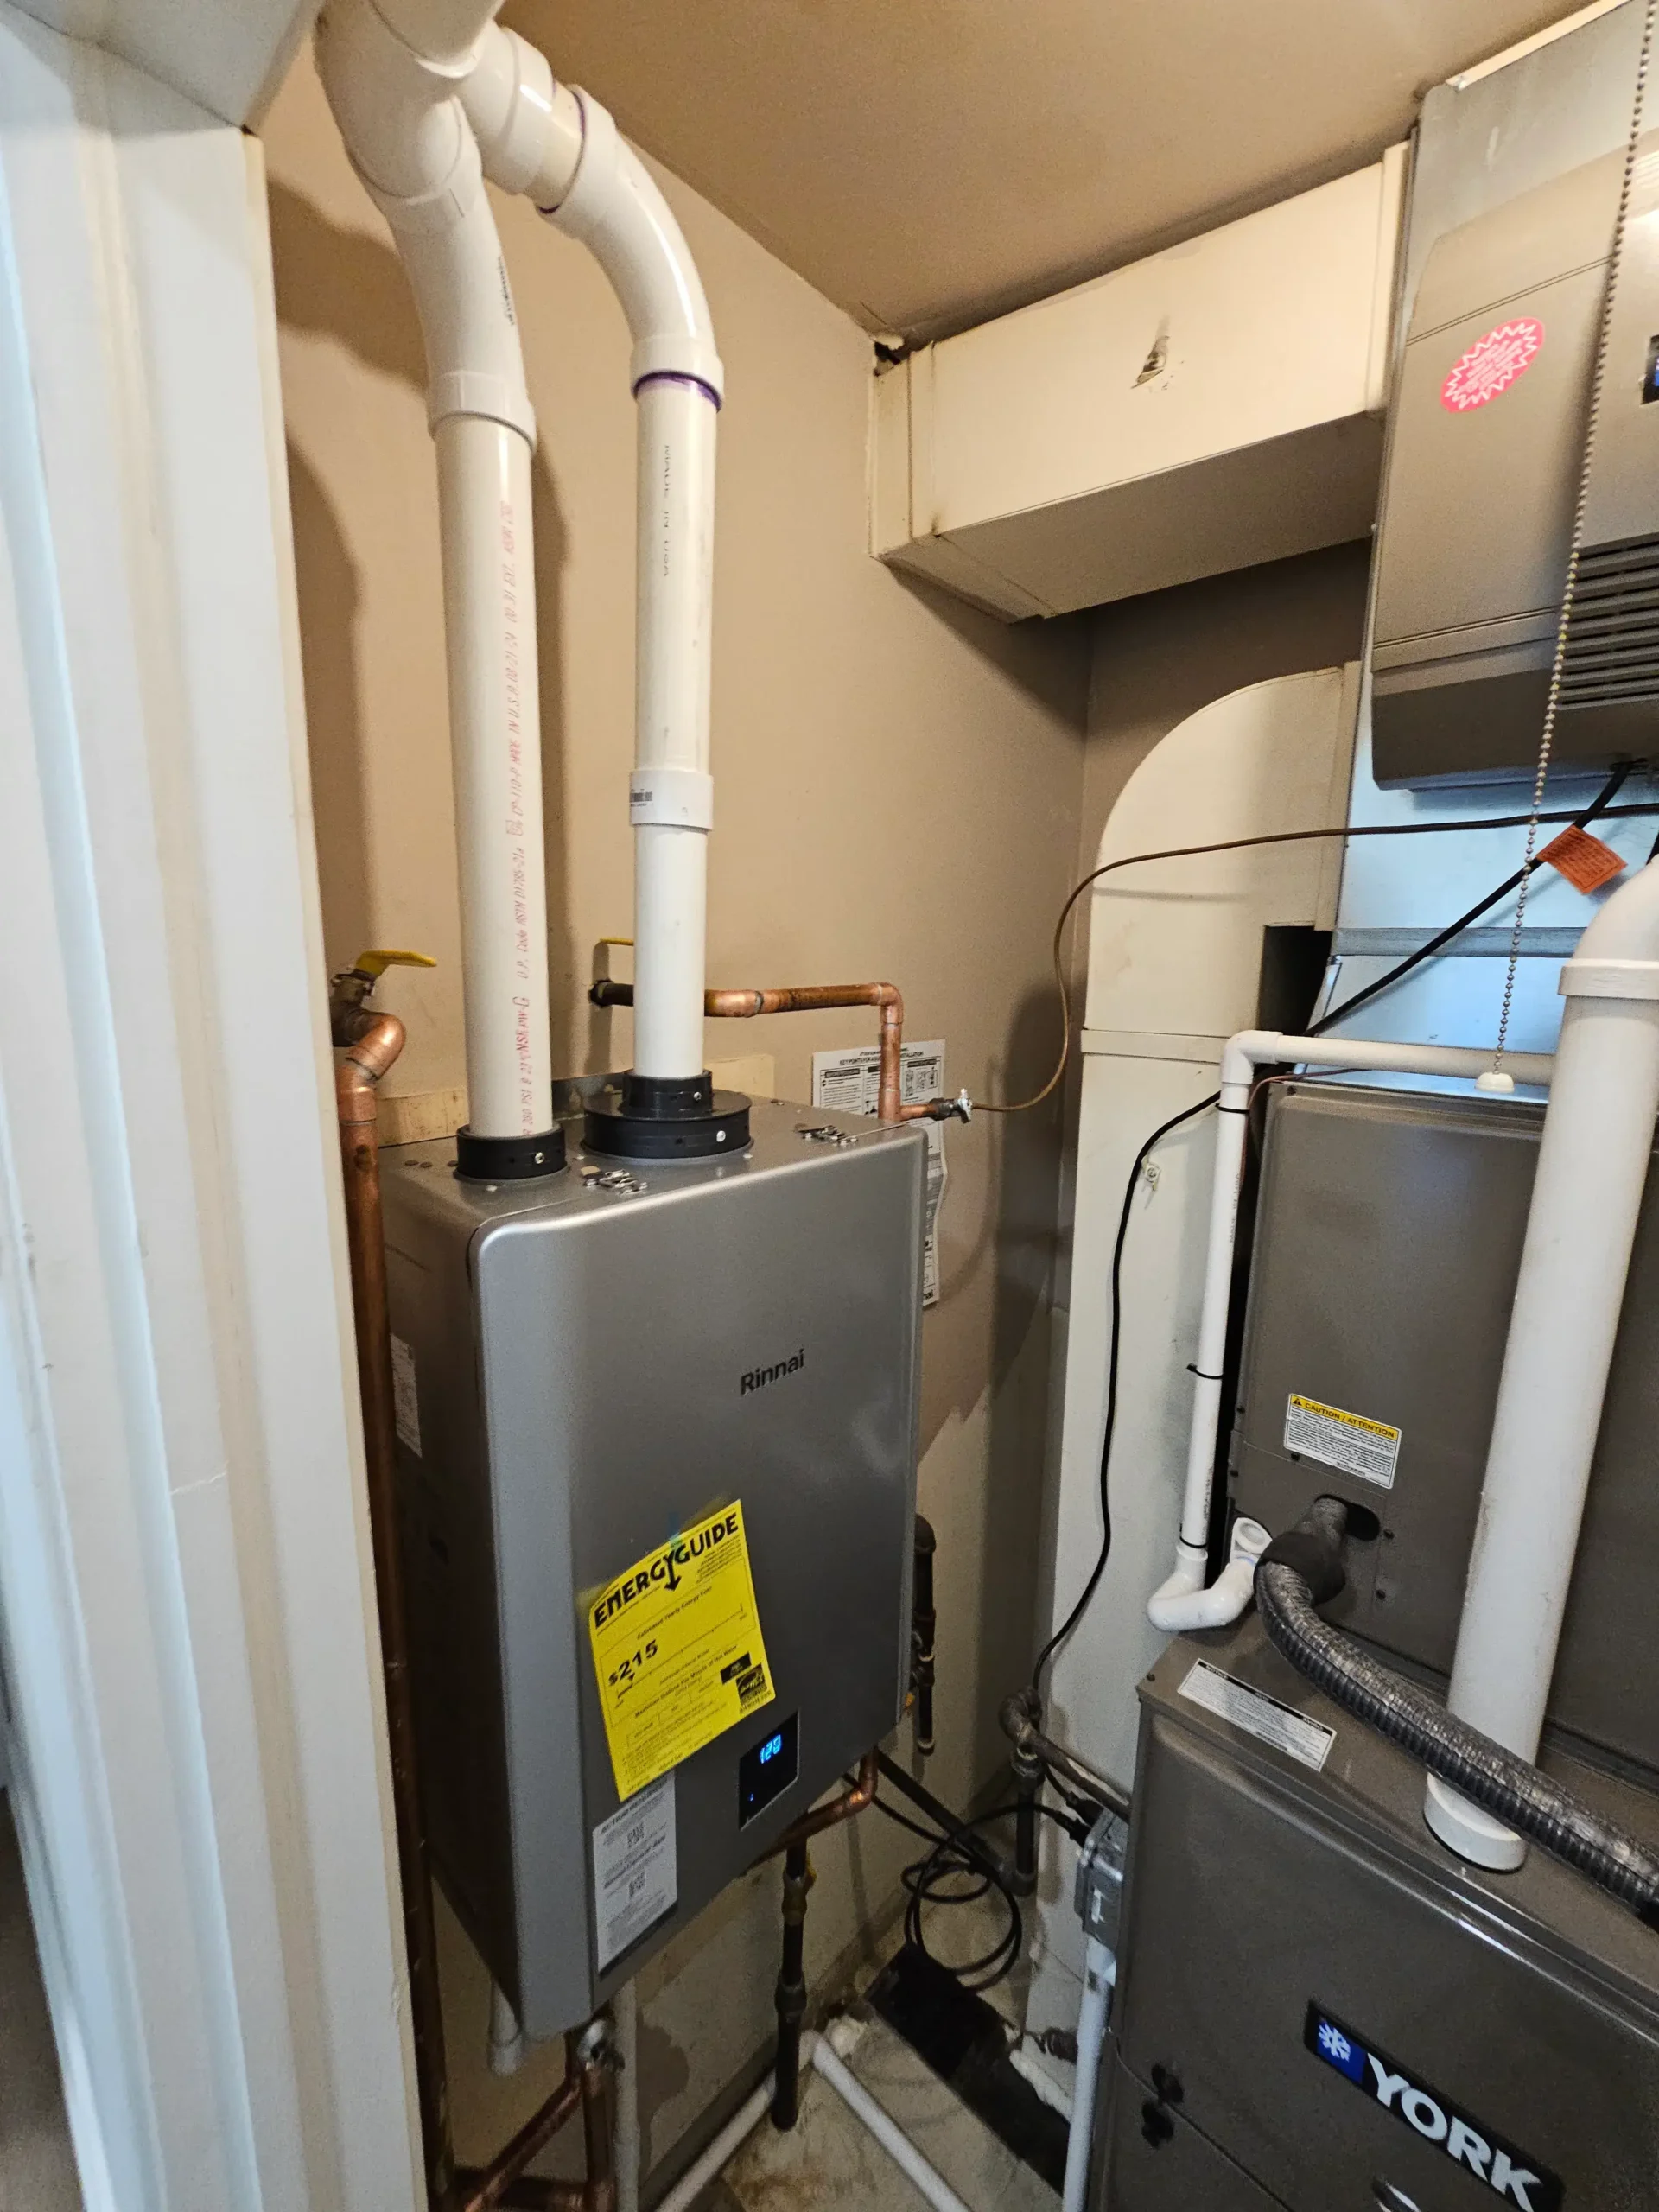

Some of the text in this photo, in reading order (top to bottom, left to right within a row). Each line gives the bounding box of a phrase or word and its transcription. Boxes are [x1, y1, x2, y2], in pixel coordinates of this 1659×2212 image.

[741, 1348, 804, 1395] Rinnai
[1305, 1402, 1341, 1420] CAUTION
[1347, 1417, 1395, 1438] ATTENTION
[608, 1639, 658, 1687] $215
[1367, 2052, 1542, 2212] YORK
